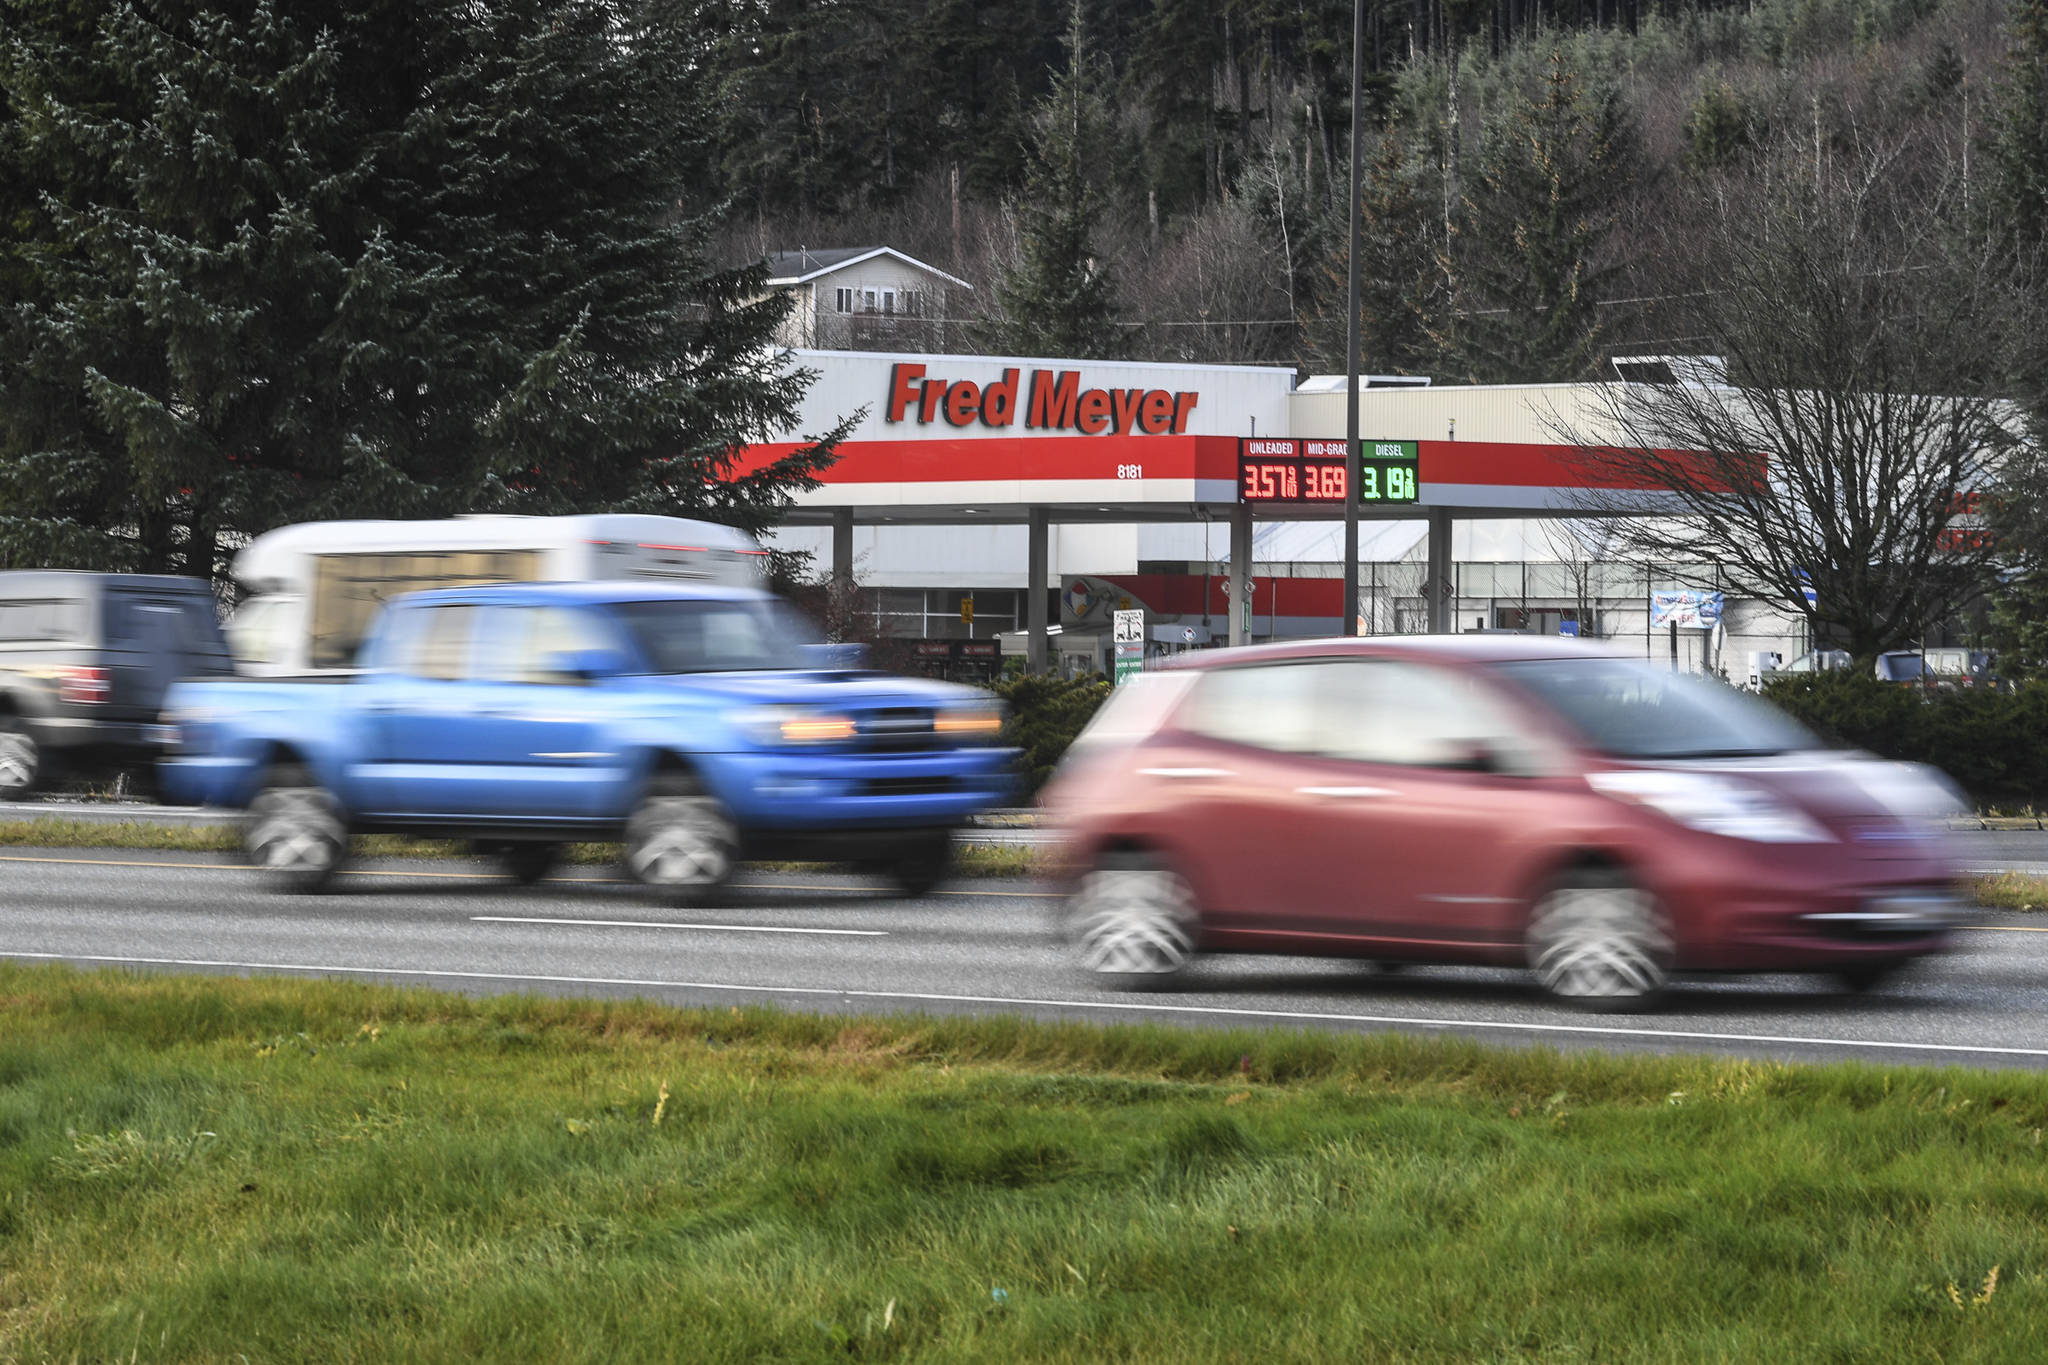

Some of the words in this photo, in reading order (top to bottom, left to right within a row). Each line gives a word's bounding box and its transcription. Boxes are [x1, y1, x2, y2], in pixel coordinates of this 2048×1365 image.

[886, 363, 1020, 427] Fred
[1025, 369, 1199, 436] Meyer
[1249, 442, 1293, 455] UNLEADED
[1307, 442, 1348, 456] MID-GRAD
[1375, 444, 1404, 457] DIESEL
[1117, 464, 1142, 479] 8181
[1304, 466, 1347, 498] 3.69
